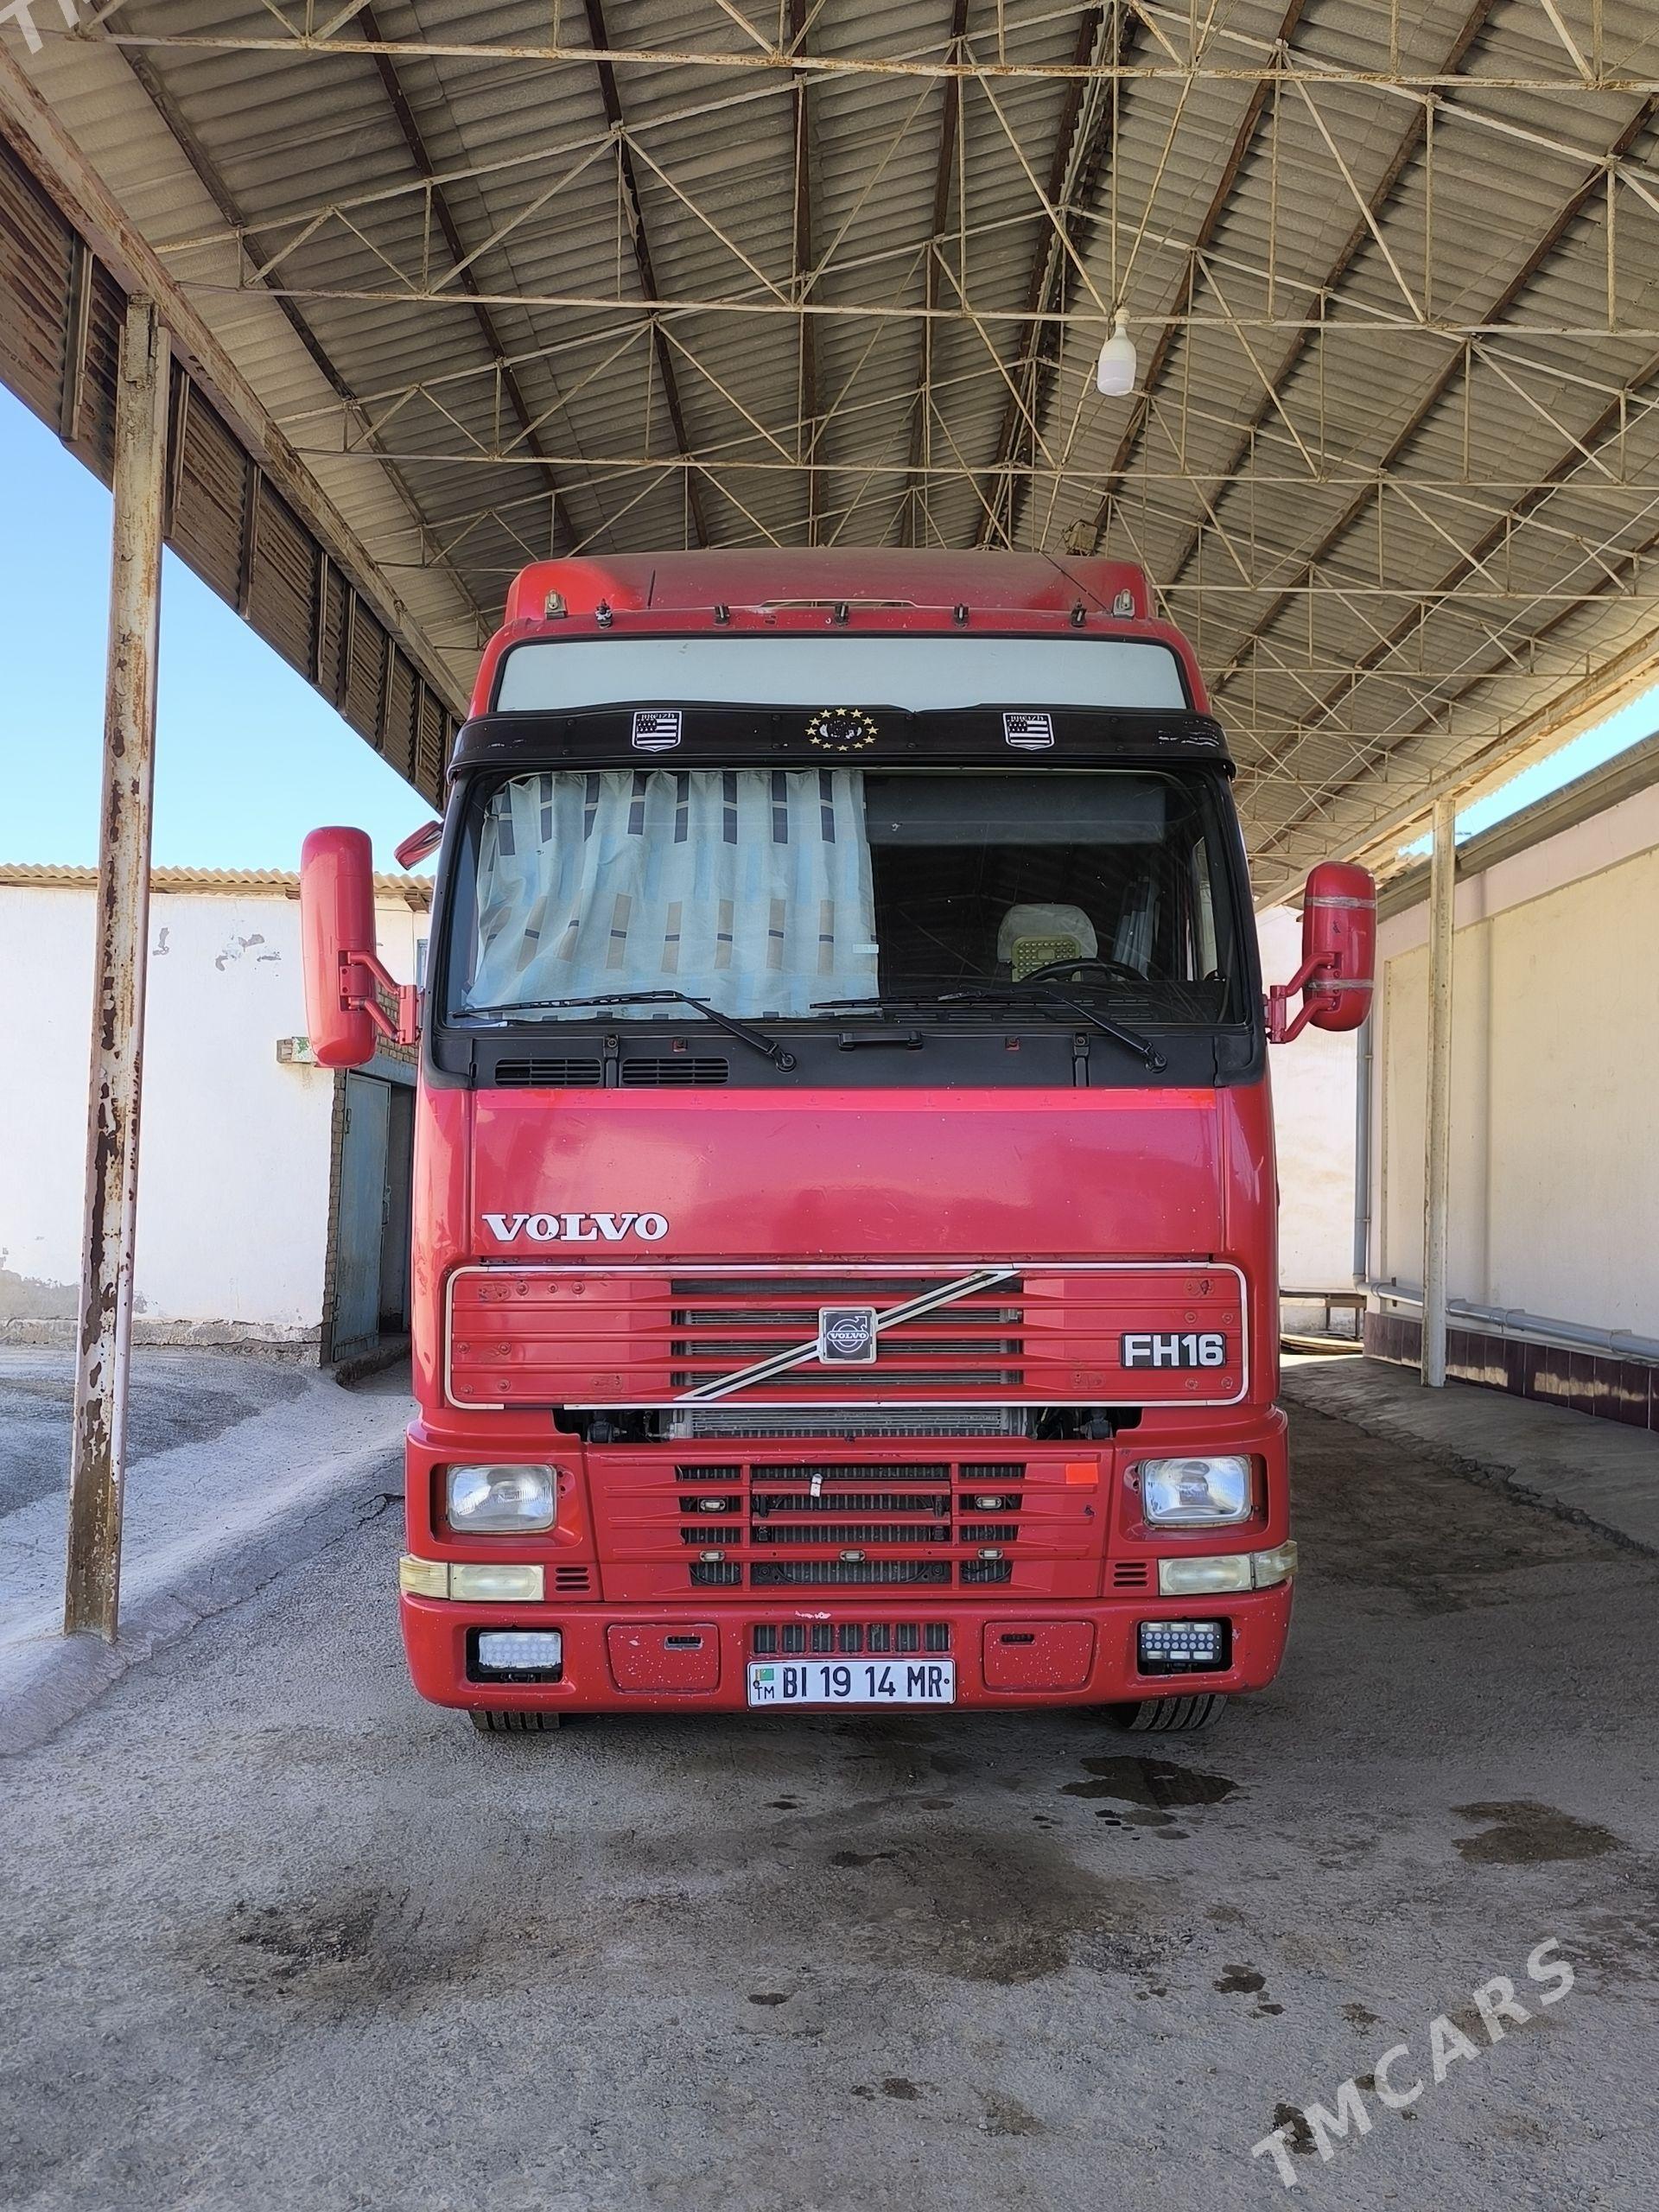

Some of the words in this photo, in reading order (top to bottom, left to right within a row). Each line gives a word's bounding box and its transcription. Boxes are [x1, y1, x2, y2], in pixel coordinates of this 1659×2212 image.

[481, 1212, 670, 1241] VOLVO
[1125, 1334, 1224, 1367] FH16
[755, 1686, 774, 1700] TM
[820, 1666, 851, 1697] 19
[865, 1666, 896, 1697] 14
[907, 1666, 943, 1698] MR
